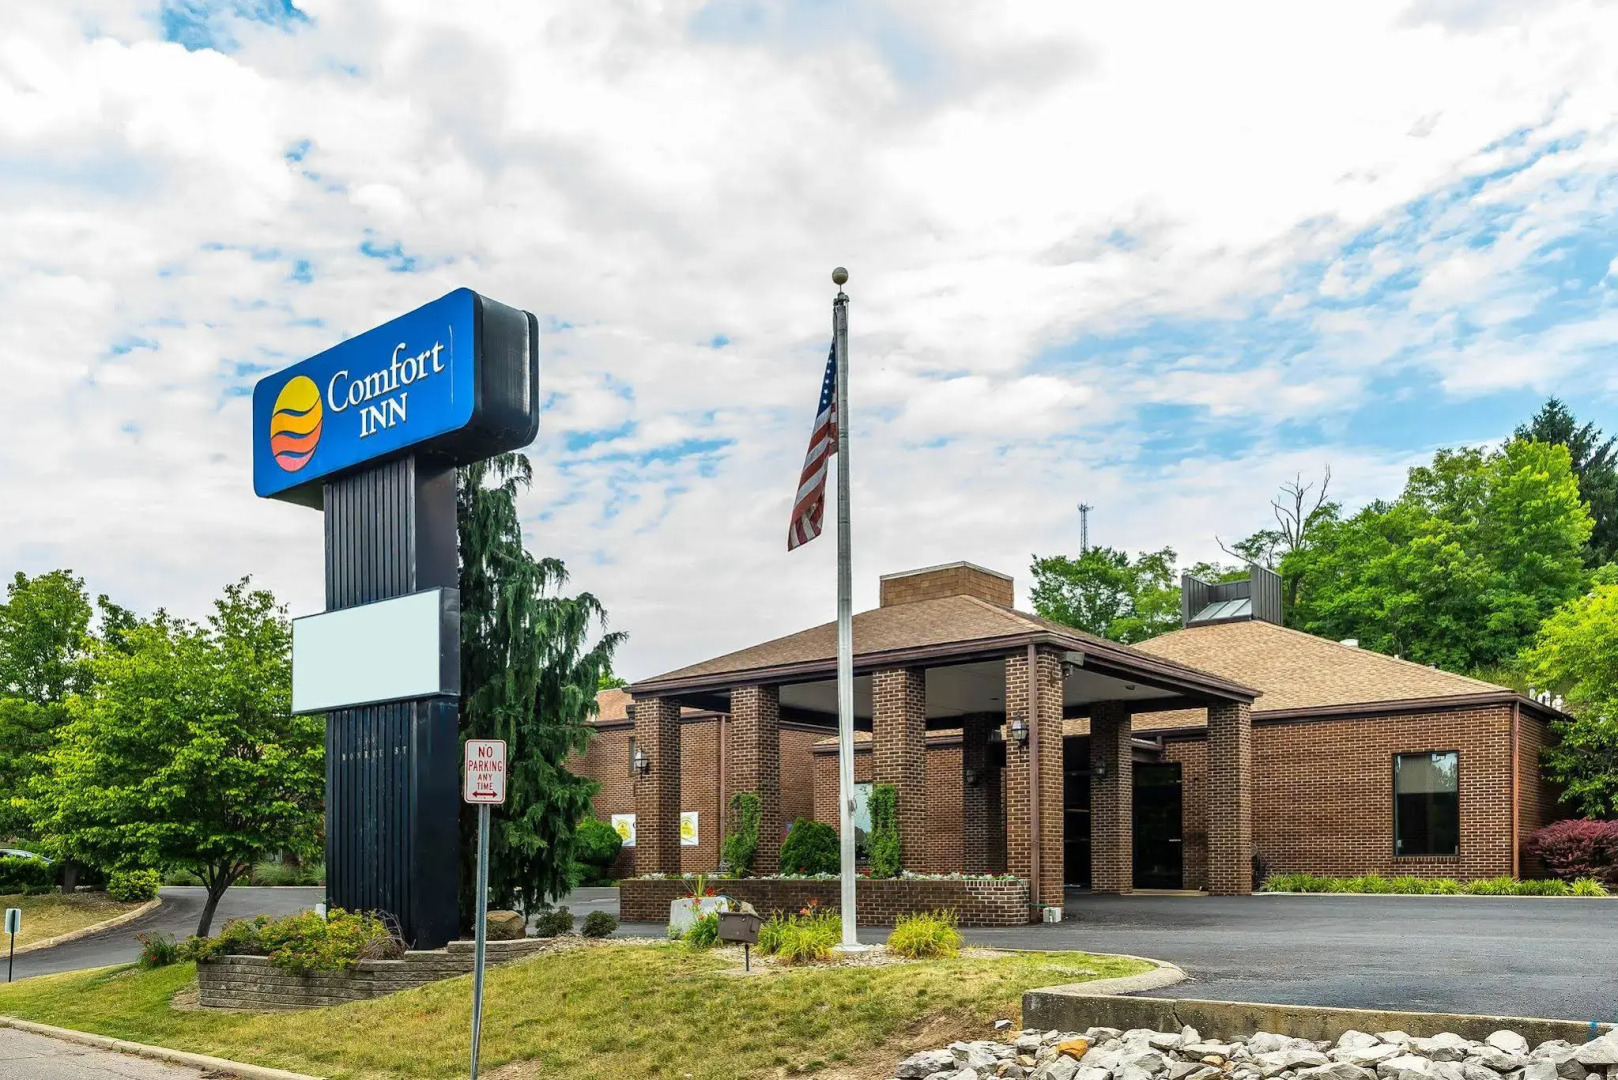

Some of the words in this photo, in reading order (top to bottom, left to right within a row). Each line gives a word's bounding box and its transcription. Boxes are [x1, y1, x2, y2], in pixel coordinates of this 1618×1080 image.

[328, 341, 446, 413] Comfort
[359, 393, 408, 438] INN
[478, 746, 493, 758] NO
[468, 760, 502, 772] PARKING
[478, 773, 493, 781] ANY
[477, 782, 493, 791] TIME
